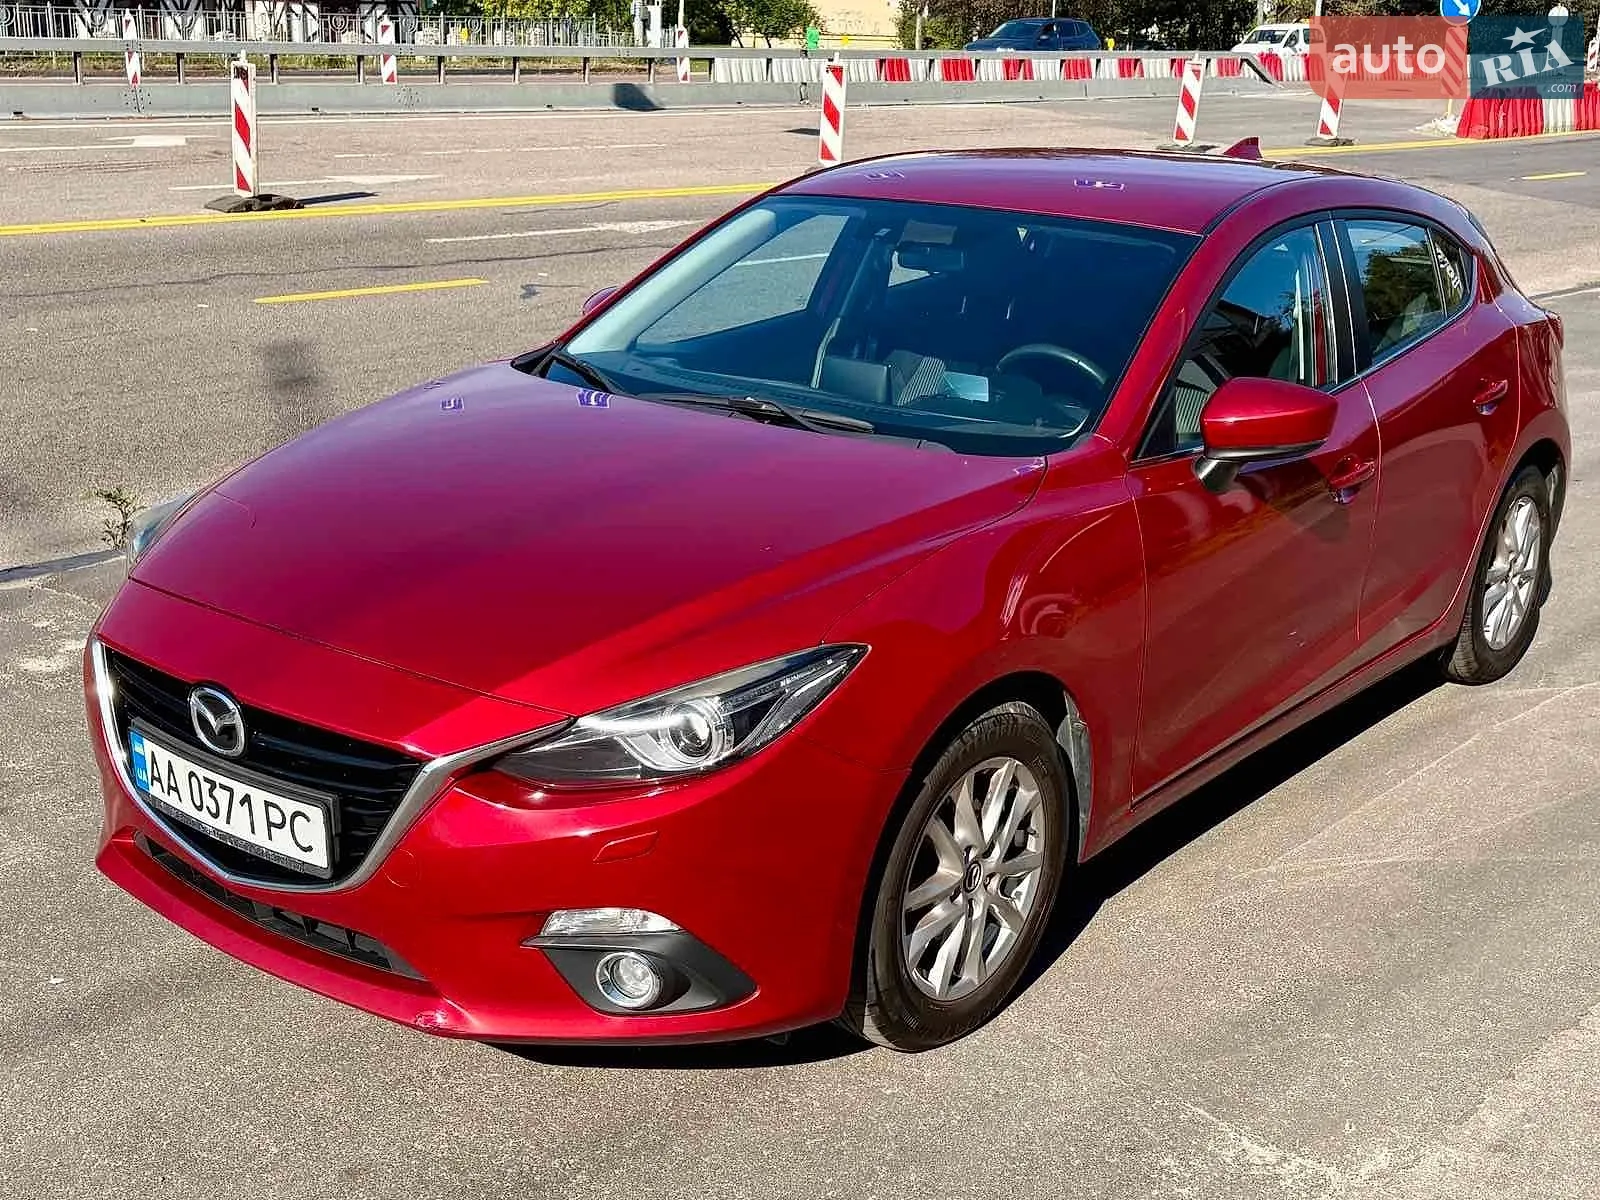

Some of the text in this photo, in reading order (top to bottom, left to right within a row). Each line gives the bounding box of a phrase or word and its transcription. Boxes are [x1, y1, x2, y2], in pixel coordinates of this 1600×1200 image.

[151, 750, 182, 803] AA
[188, 771, 256, 834] 0371
[263, 800, 313, 852] PC
